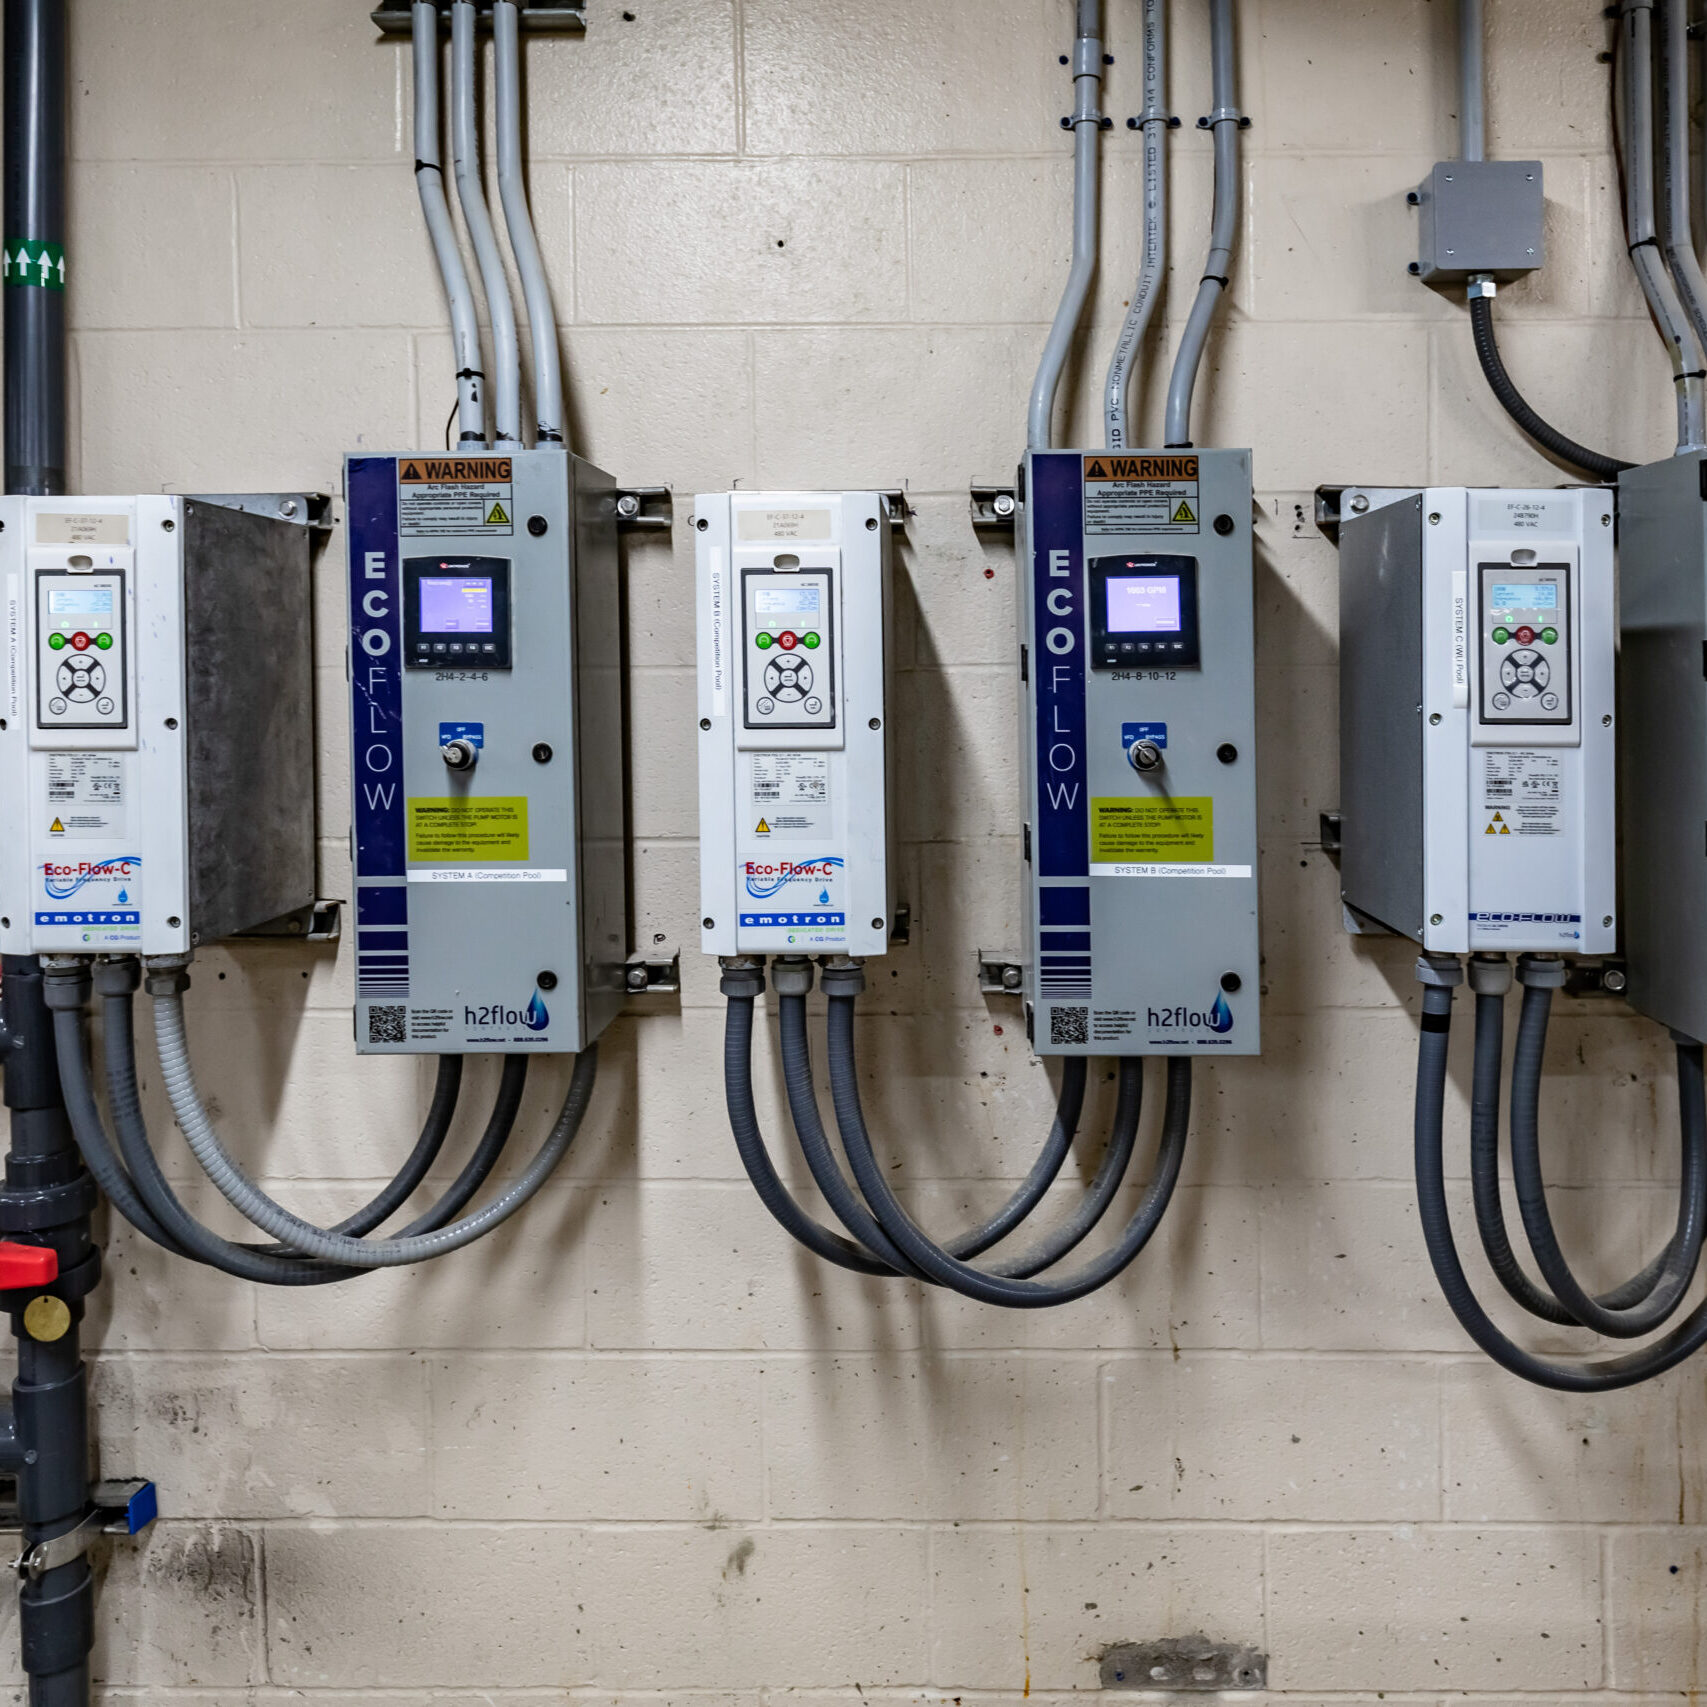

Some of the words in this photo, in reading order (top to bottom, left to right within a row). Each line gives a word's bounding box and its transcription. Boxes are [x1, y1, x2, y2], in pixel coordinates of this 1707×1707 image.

[1147, 22, 1156, 81] CONFORMS
[1148, 147, 1157, 192] LISTED
[1132, 273, 1152, 314] CONDUIT
[1111, 319, 1138, 390] NONMETALLIC
[1110, 398, 1120, 421] PVC
[424, 461, 512, 479] WARNING
[1110, 459, 1198, 477] WARNING
[712, 572, 720, 609] SYSTEM
[1455, 598, 1464, 633] SYSTEM
[435, 672, 489, 681] 2H4-2-4-6
[1111, 672, 1176, 681] 2H4-8-10-12
[44, 862, 131, 876] Eco-Flow-C
[475, 872, 520, 881] (Competition
[523, 871, 542, 880] Pool)
[745, 862, 832, 875] Eco-Flow-C
[1114, 866, 1148, 874] SYSTEM
[1158, 867, 1205, 875] (Competition
[1207, 867, 1226, 875] Pool)
[40, 914, 135, 922] emotron
[745, 915, 840, 924] emotron
[465, 1005, 537, 1025] h2flow
[1148, 1007, 1220, 1027] h2flow
